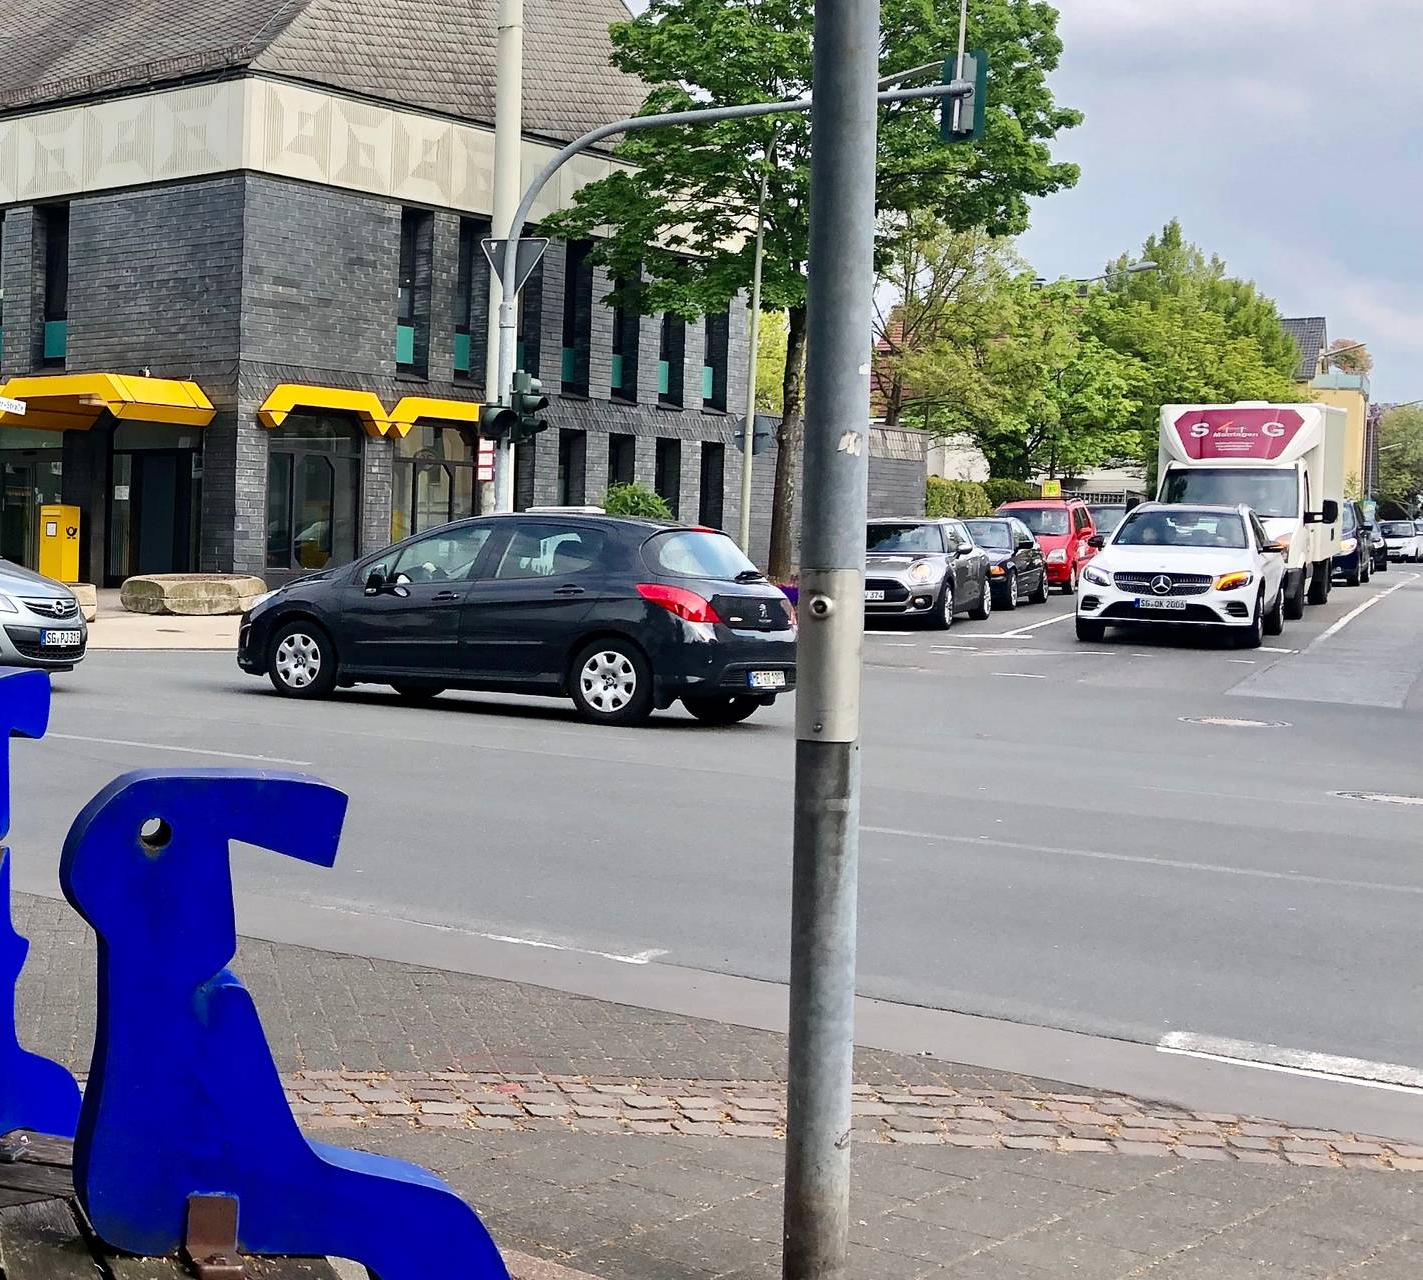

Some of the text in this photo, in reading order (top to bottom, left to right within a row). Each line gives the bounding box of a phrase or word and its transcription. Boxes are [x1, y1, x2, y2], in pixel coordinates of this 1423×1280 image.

[1190, 421, 1285, 438] S G
[1140, 599, 1151, 607] SG
[46, 632, 57, 644] SG
